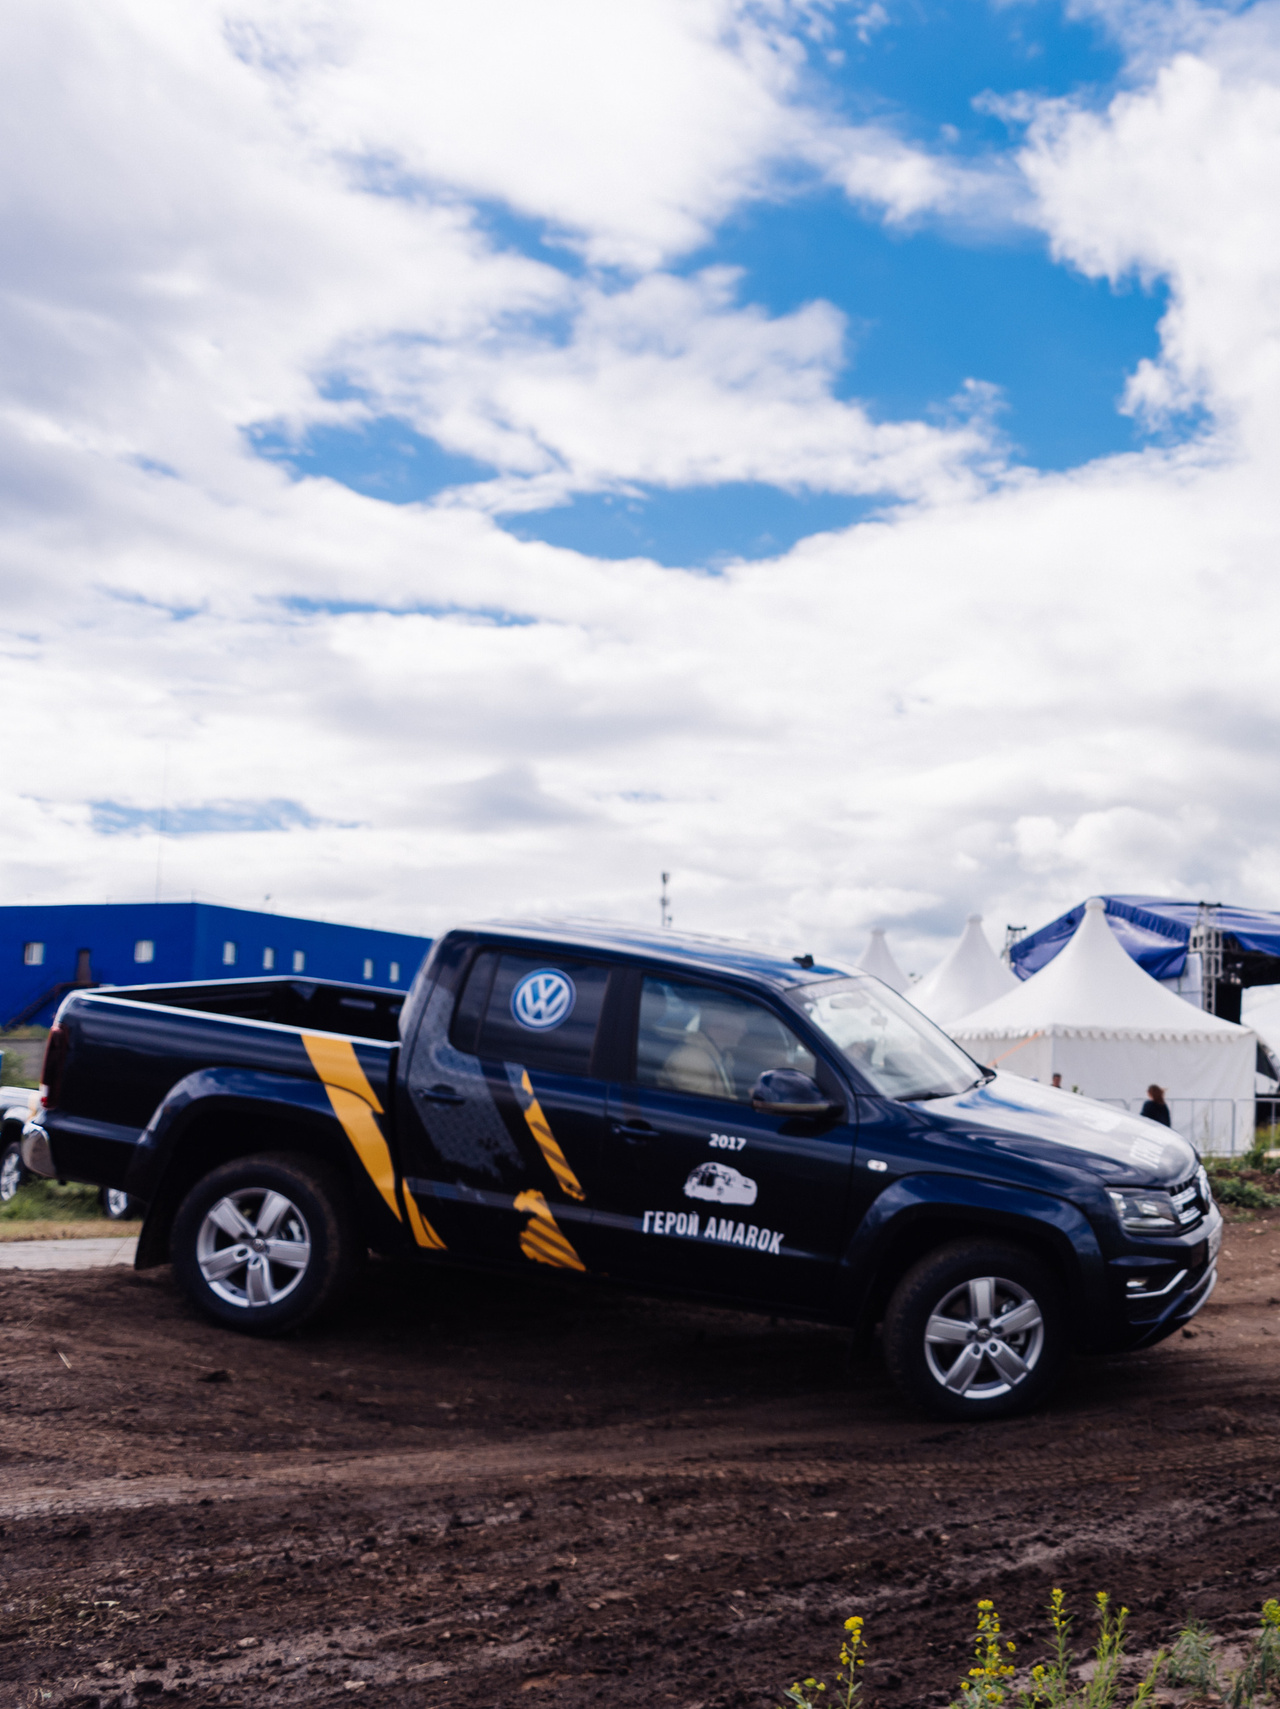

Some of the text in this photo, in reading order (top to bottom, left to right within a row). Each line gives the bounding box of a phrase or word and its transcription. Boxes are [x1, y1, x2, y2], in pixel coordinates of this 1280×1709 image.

[708, 1133, 747, 1151] 2017
[642, 1210, 785, 1255] ГЕРОЙ AMAROK
